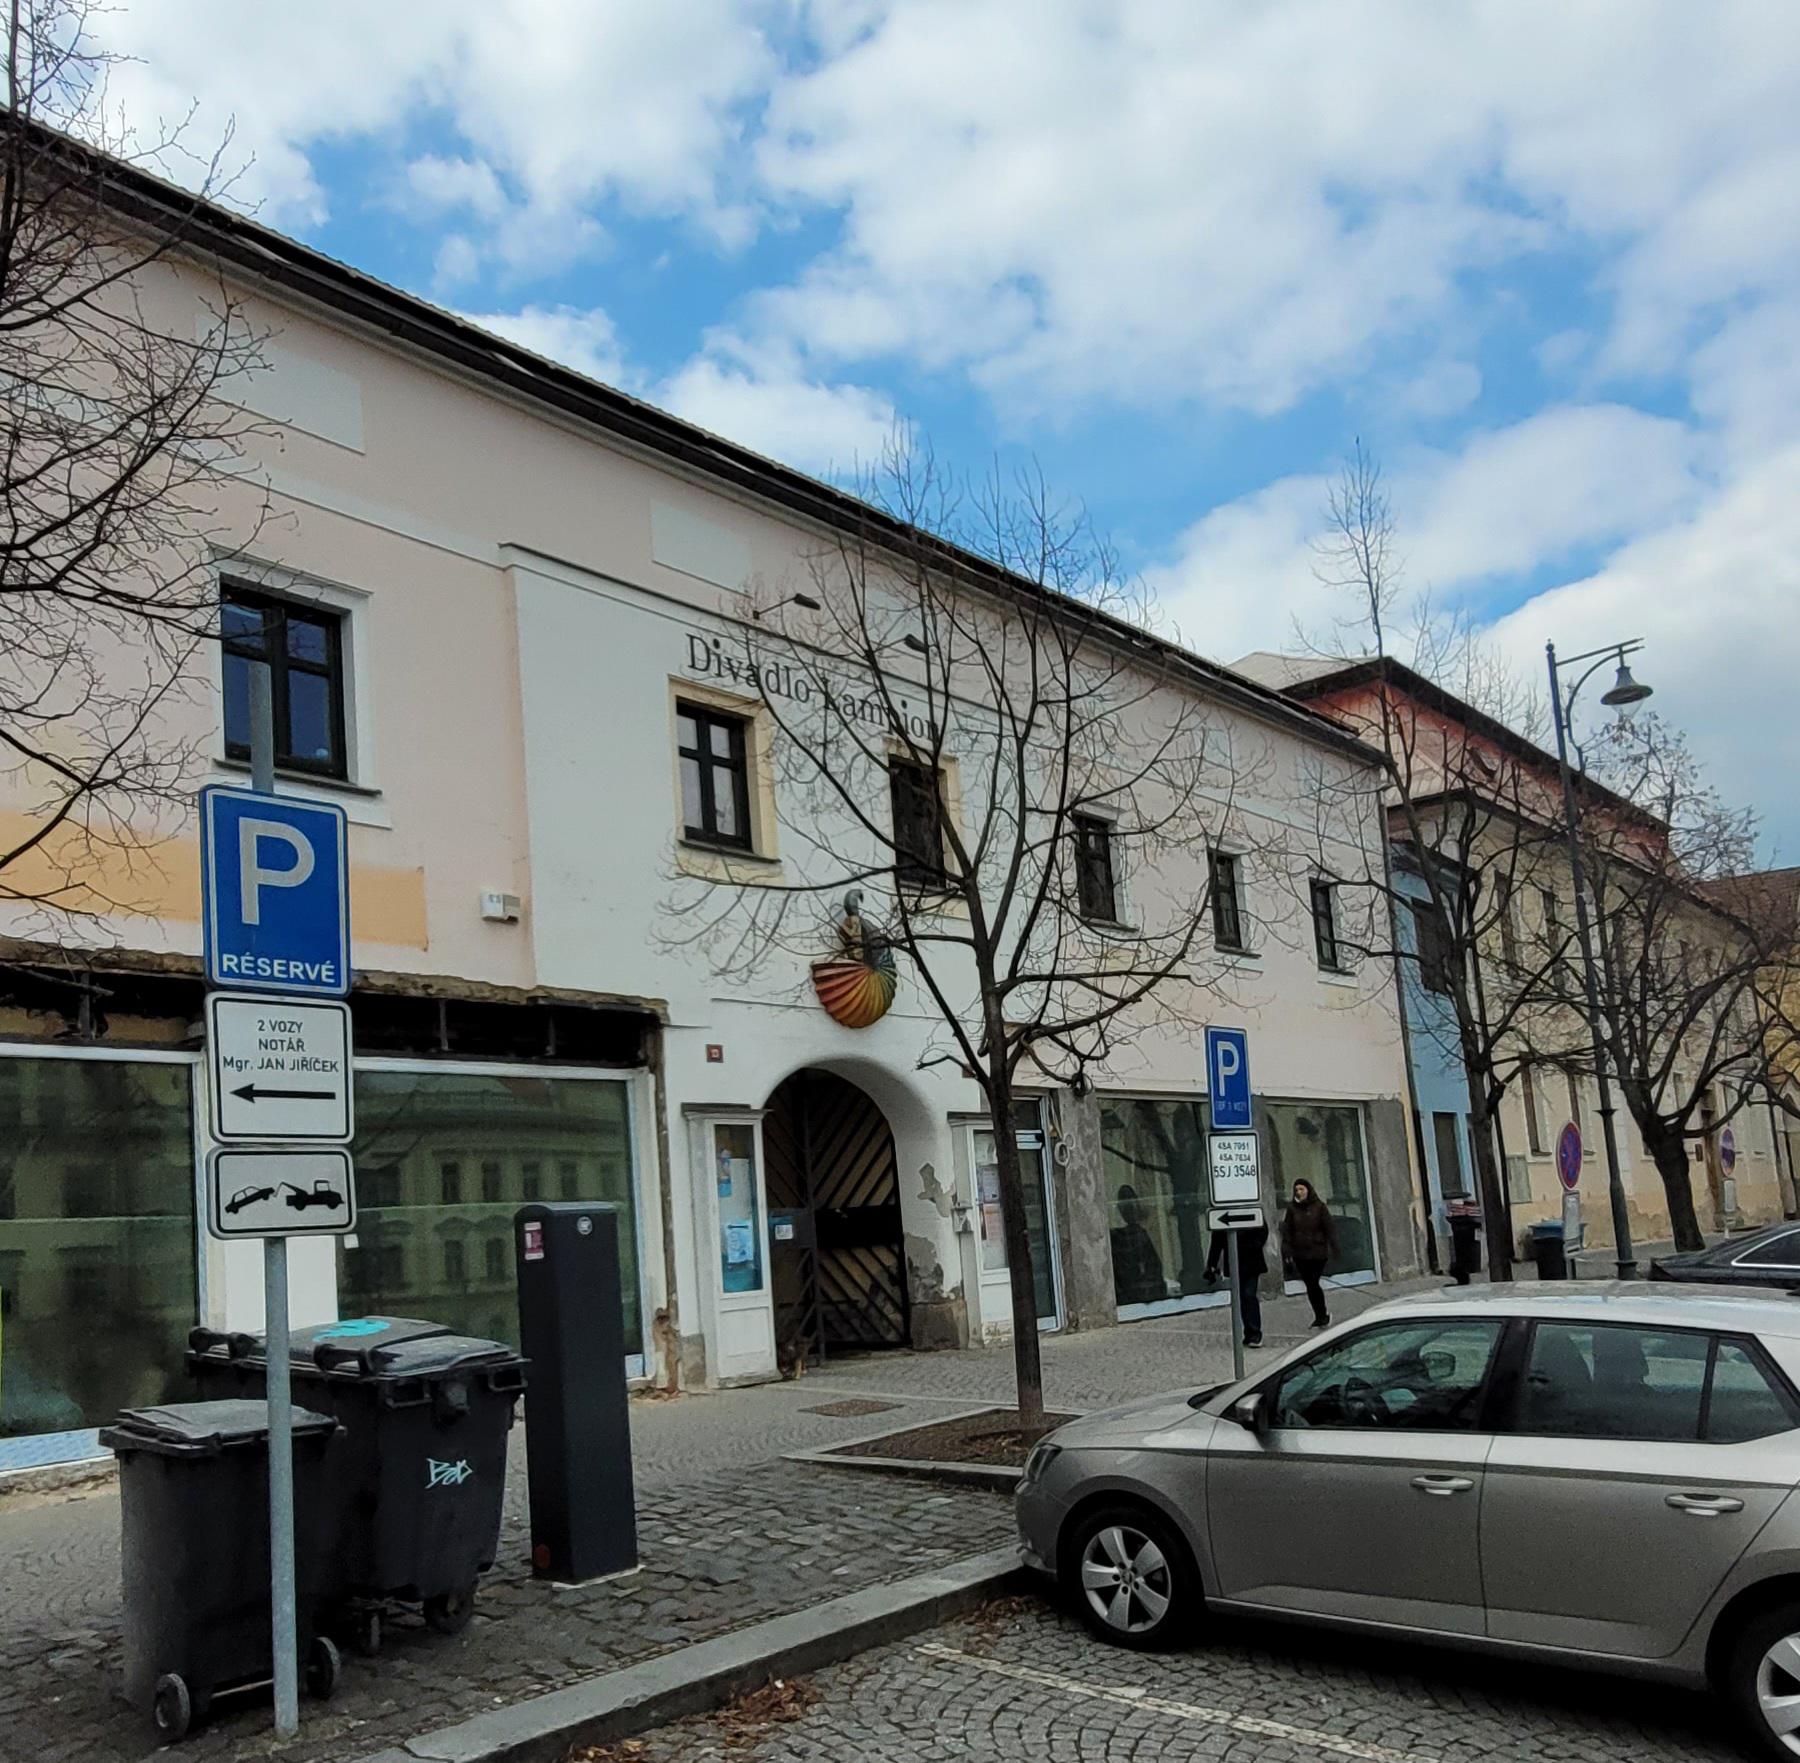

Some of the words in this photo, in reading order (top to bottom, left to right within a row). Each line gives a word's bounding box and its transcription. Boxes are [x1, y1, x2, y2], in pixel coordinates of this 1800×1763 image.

[685, 632, 810, 704] Divadlo
[238, 816, 316, 926] P
[222, 951, 336, 984] RÉSERVÉ
[257, 1019, 266, 1032] 2
[269, 1019, 304, 1034] VOZY
[258, 1037, 306, 1053] NOTÁŘ
[223, 1055, 254, 1072] Mgr.
[257, 1057, 285, 1071] JAN
[289, 1057, 339, 1073] JIŘÍČEK
[1217, 1040, 1240, 1097] P
[1213, 1165, 1231, 1178] 5SJ
[1233, 1164, 1256, 1178] 3548
